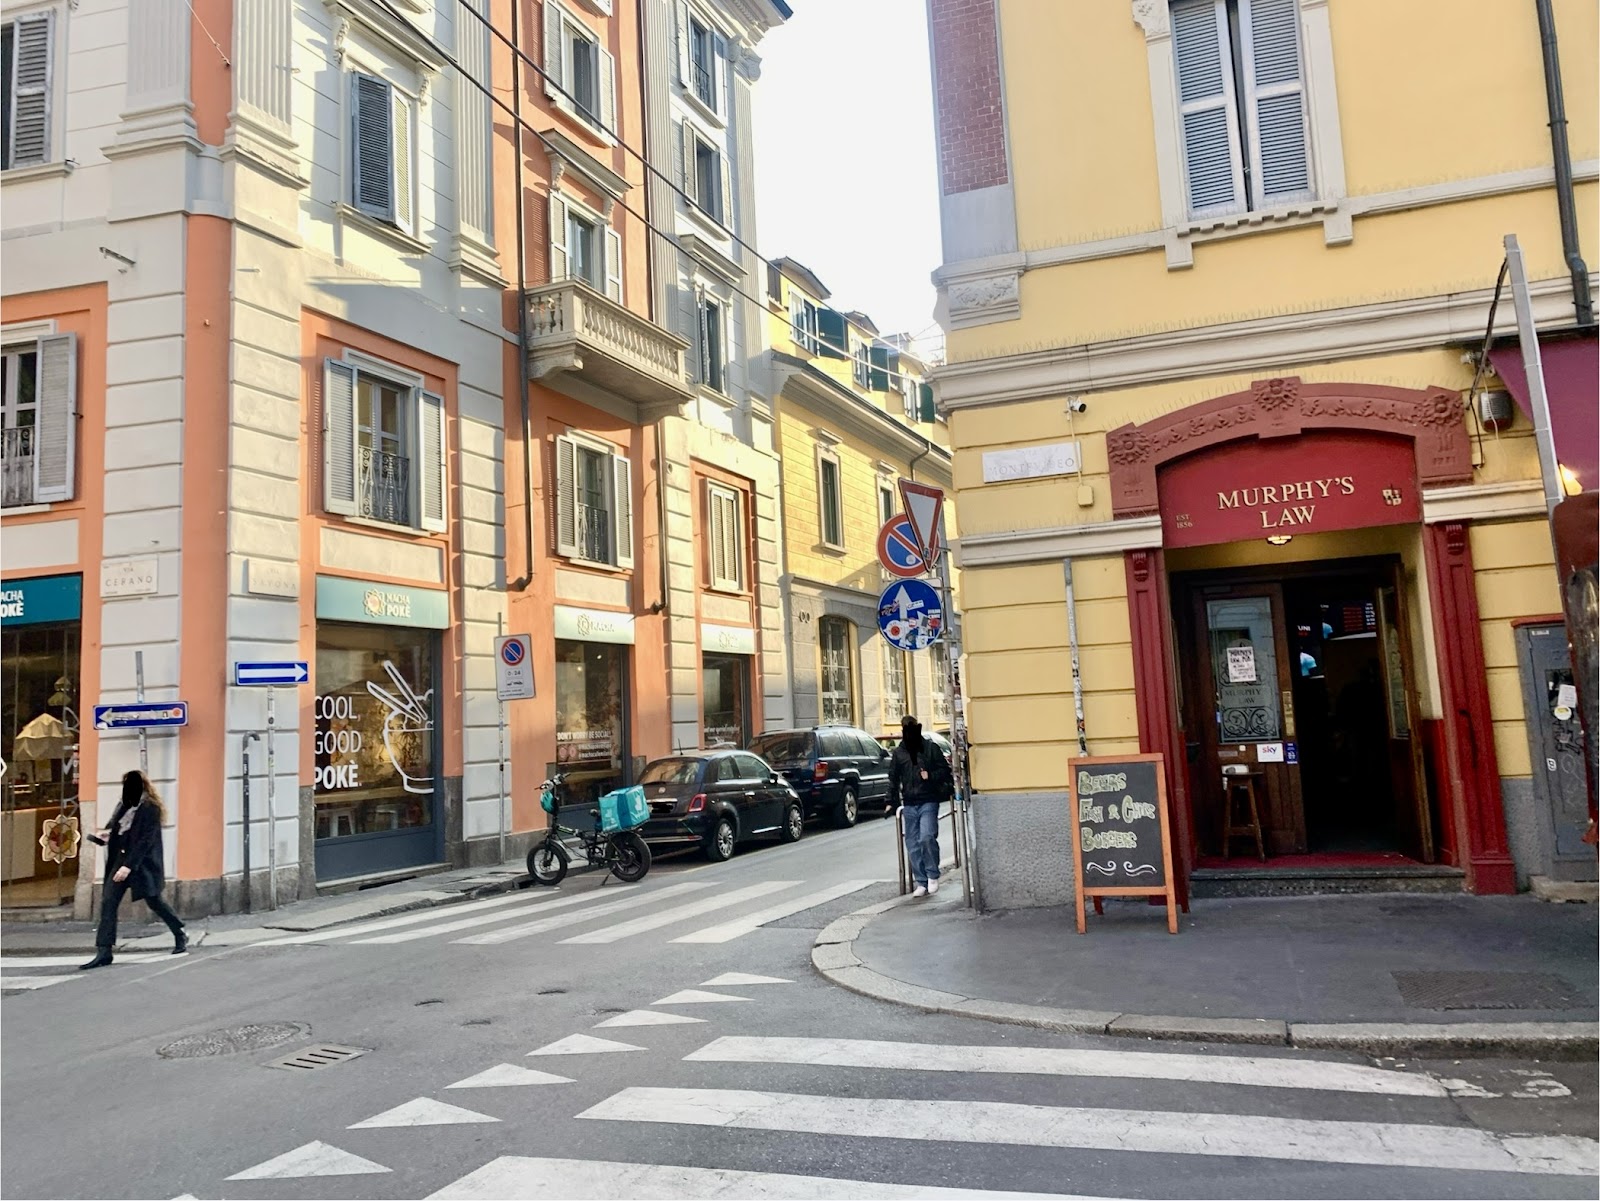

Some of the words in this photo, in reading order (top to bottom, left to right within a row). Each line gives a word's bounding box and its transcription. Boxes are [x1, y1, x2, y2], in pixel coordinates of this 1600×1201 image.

[1217, 476, 1355, 510] MURPHY'S
[1260, 505, 1316, 529] LAW
[105, 575, 153, 587] CERANO
[252, 578, 297, 591] SAVONA
[1, 590, 24, 602] ACHA
[1, 600, 24, 618] OKÈ
[1262, 745, 1277, 755] sky
